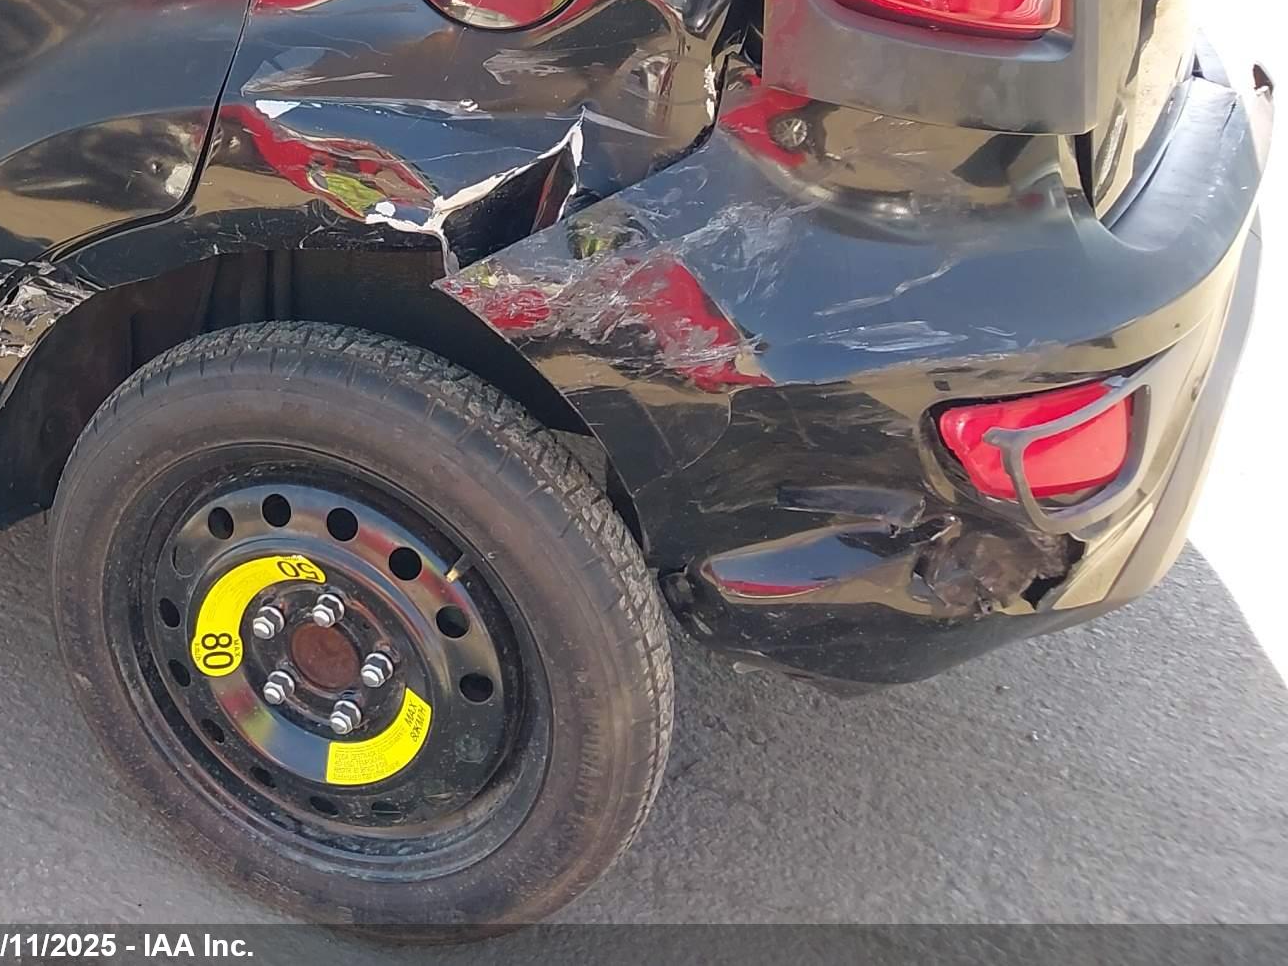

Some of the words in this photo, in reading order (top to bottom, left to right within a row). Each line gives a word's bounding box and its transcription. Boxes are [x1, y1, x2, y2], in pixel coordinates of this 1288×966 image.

[277, 560, 320, 580] 50
[201, 632, 234, 669] 80
[403, 699, 418, 727] MAX
